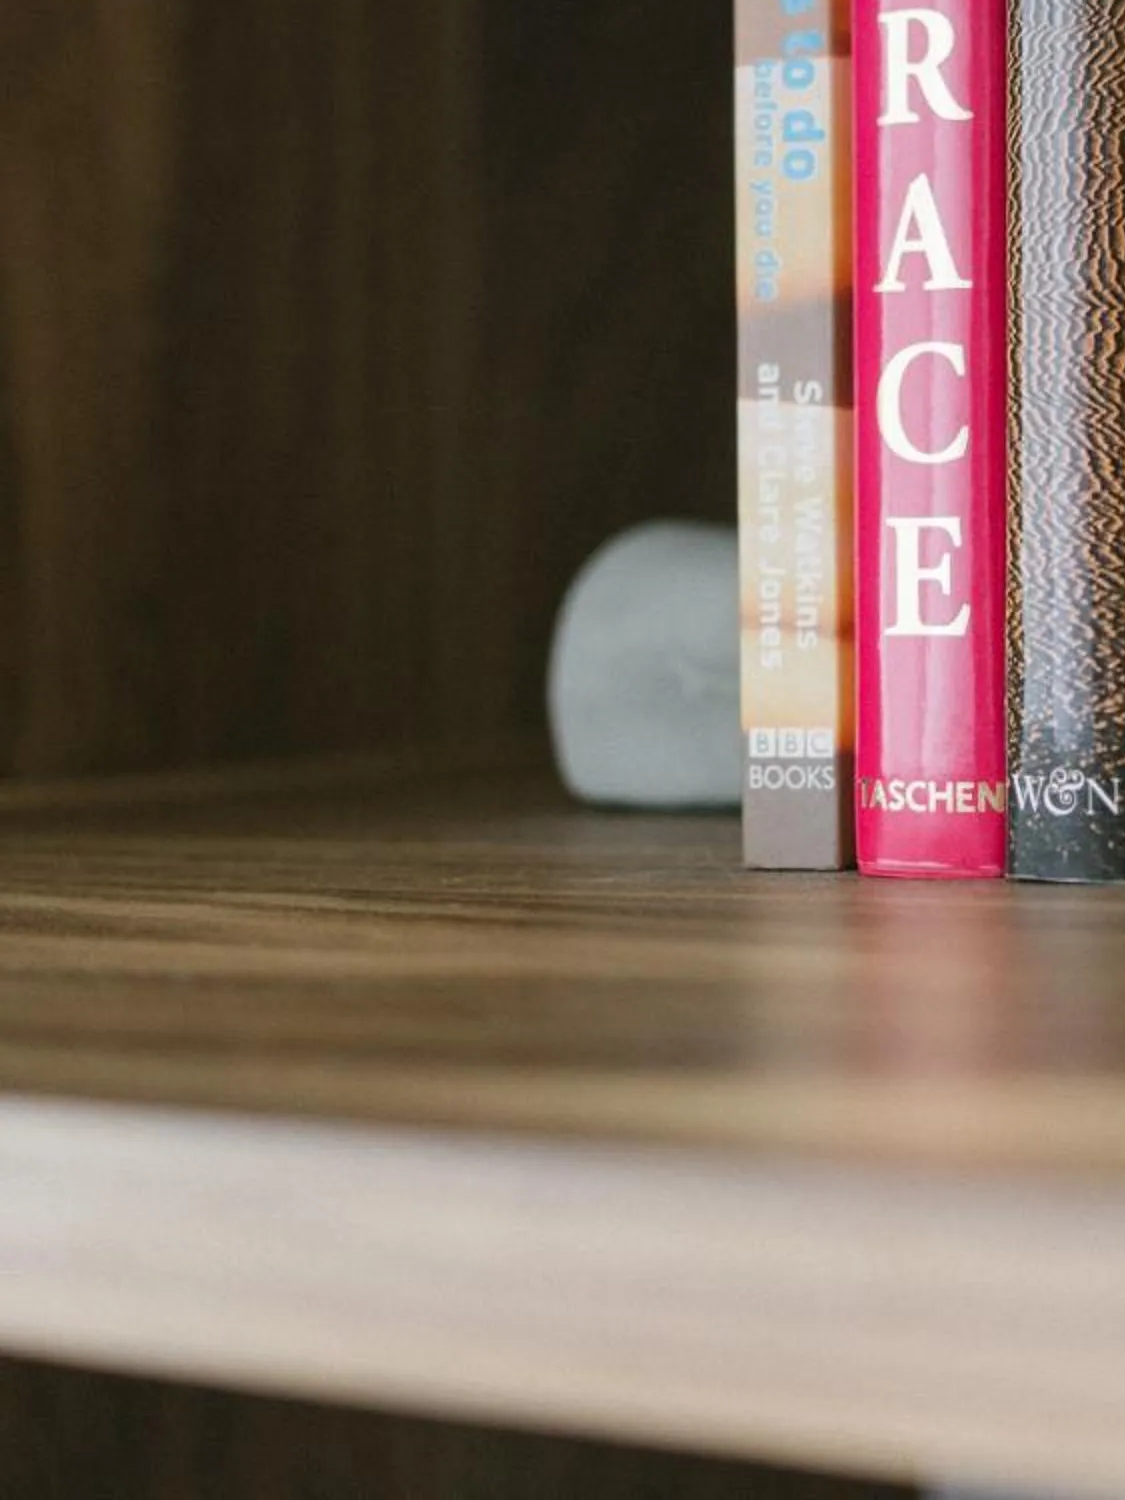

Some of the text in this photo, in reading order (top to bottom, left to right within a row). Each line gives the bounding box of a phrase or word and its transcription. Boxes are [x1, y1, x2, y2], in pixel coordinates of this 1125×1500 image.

[780, 30, 825, 90] to
[780, 109, 826, 182] do
[750, 729, 832, 757] BBC
[749, 764, 835, 790] BOOKS
[858, 778, 1007, 814] TASCHEN
[1011, 767, 1120, 817] W&N
